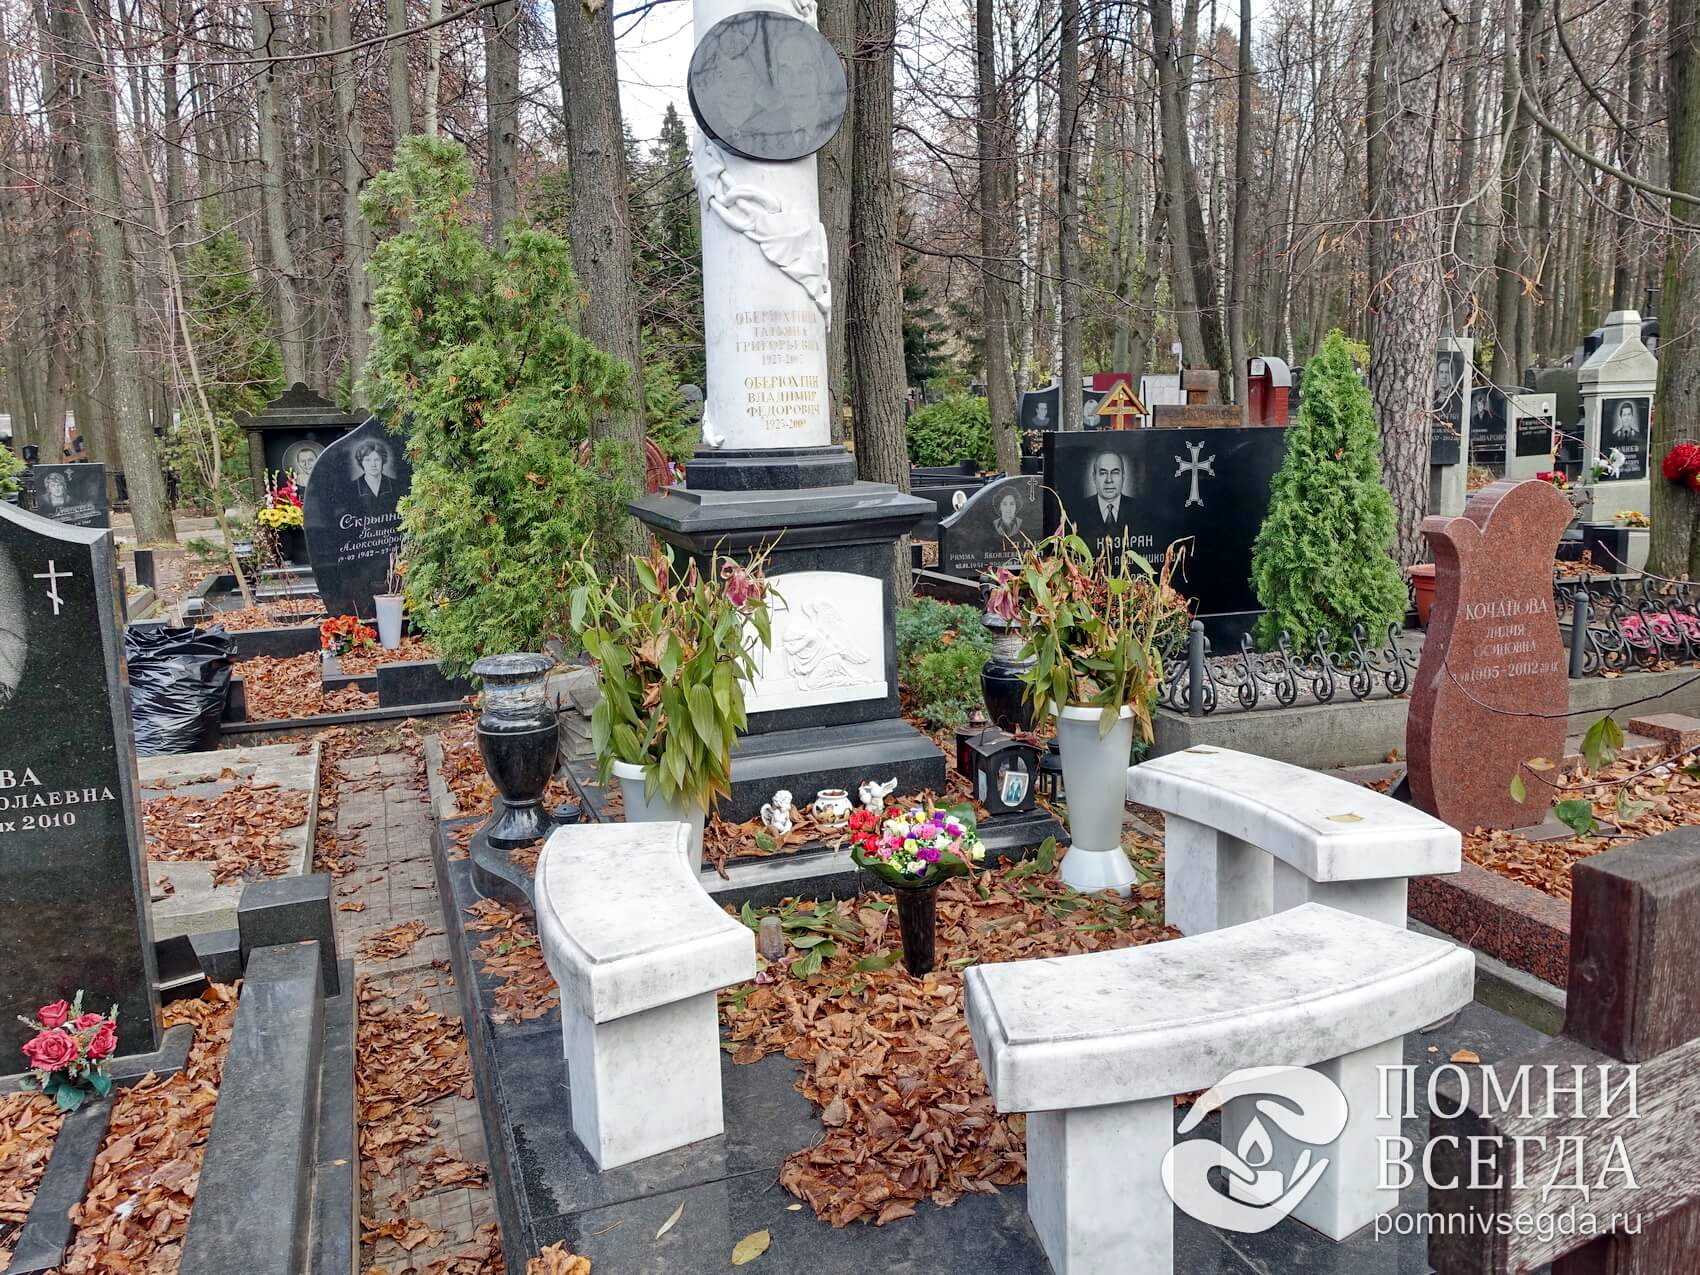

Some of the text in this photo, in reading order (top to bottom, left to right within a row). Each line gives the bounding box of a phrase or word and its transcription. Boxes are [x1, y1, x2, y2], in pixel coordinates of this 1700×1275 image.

[747, 391, 817, 403] ВЛАДИМИР
[1465, 597, 1549, 621] КОЧАНОВА
[22, 811, 76, 830] 2010
